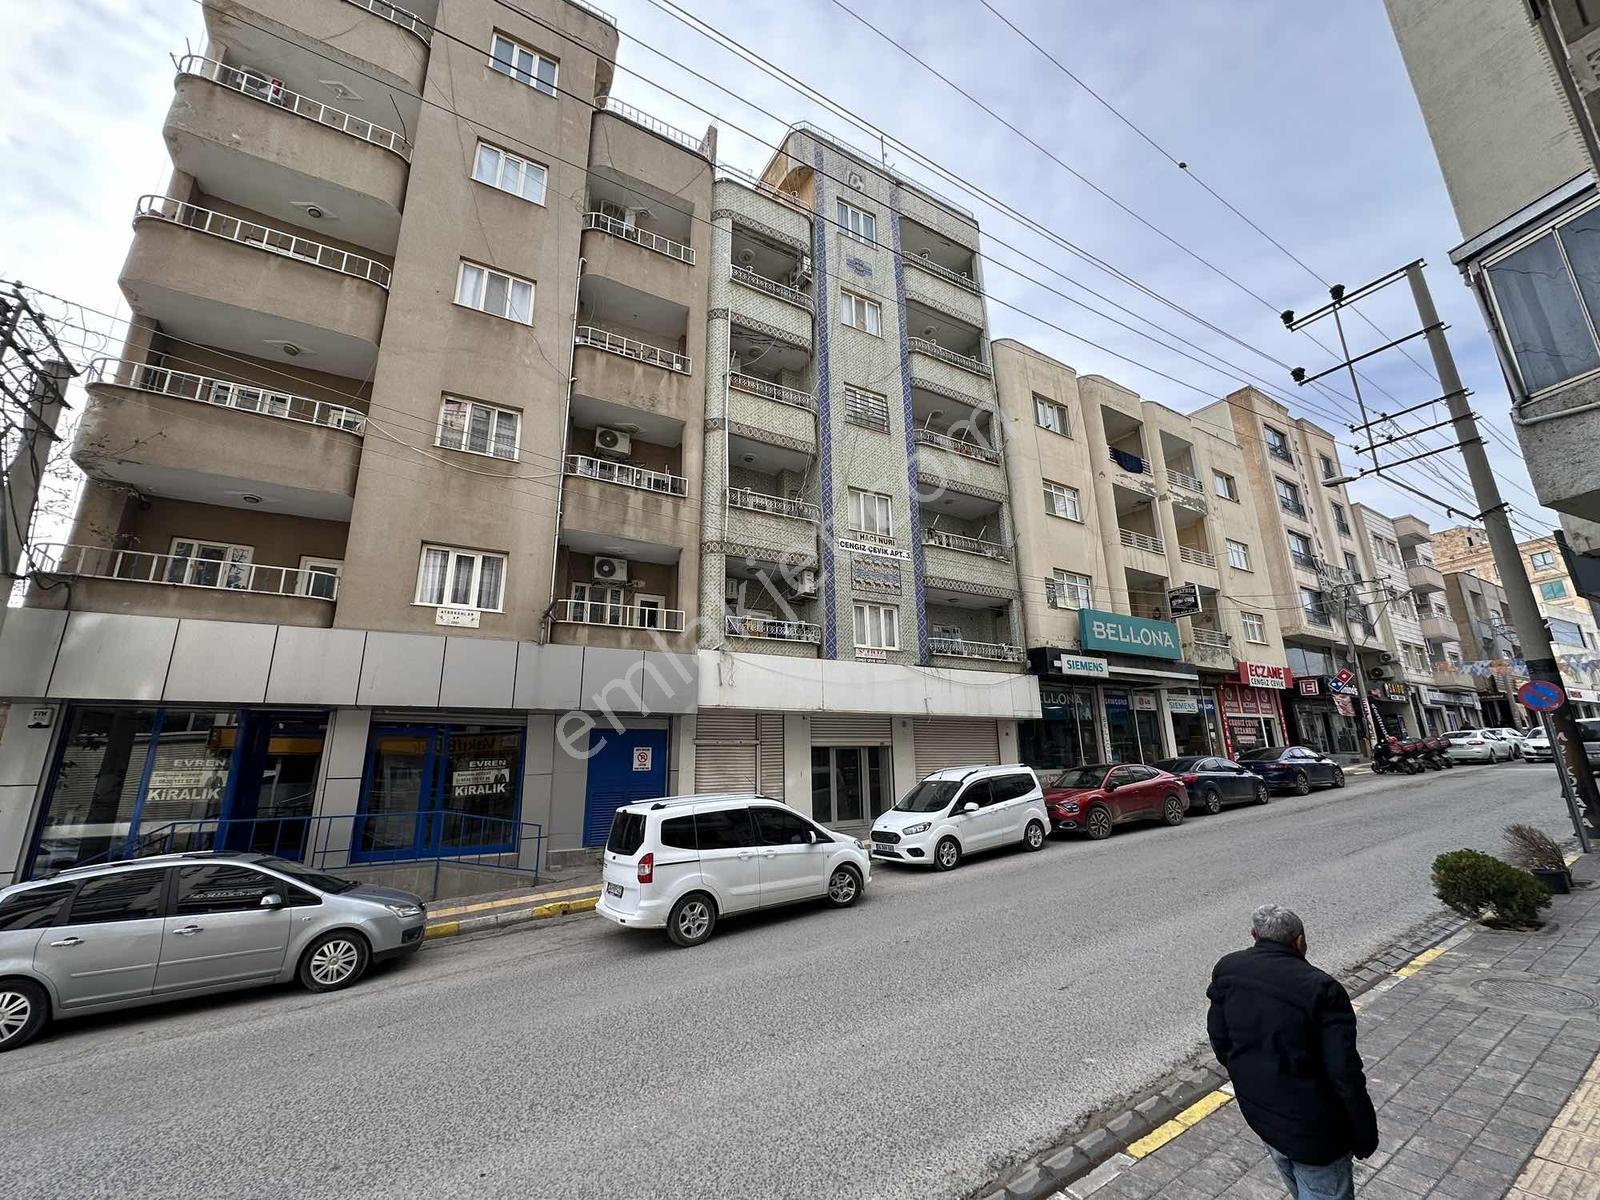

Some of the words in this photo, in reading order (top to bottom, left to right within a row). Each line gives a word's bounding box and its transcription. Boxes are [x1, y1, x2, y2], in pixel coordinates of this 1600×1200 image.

[1092, 620, 1175, 649] BELLONA
[1066, 659, 1104, 673] SIEMENS
[1249, 664, 1284, 680] ECZANE
[1169, 701, 1197, 710] SIEMENS
[173, 758, 227, 768] EVREN
[469, 759, 507, 768] EVREN
